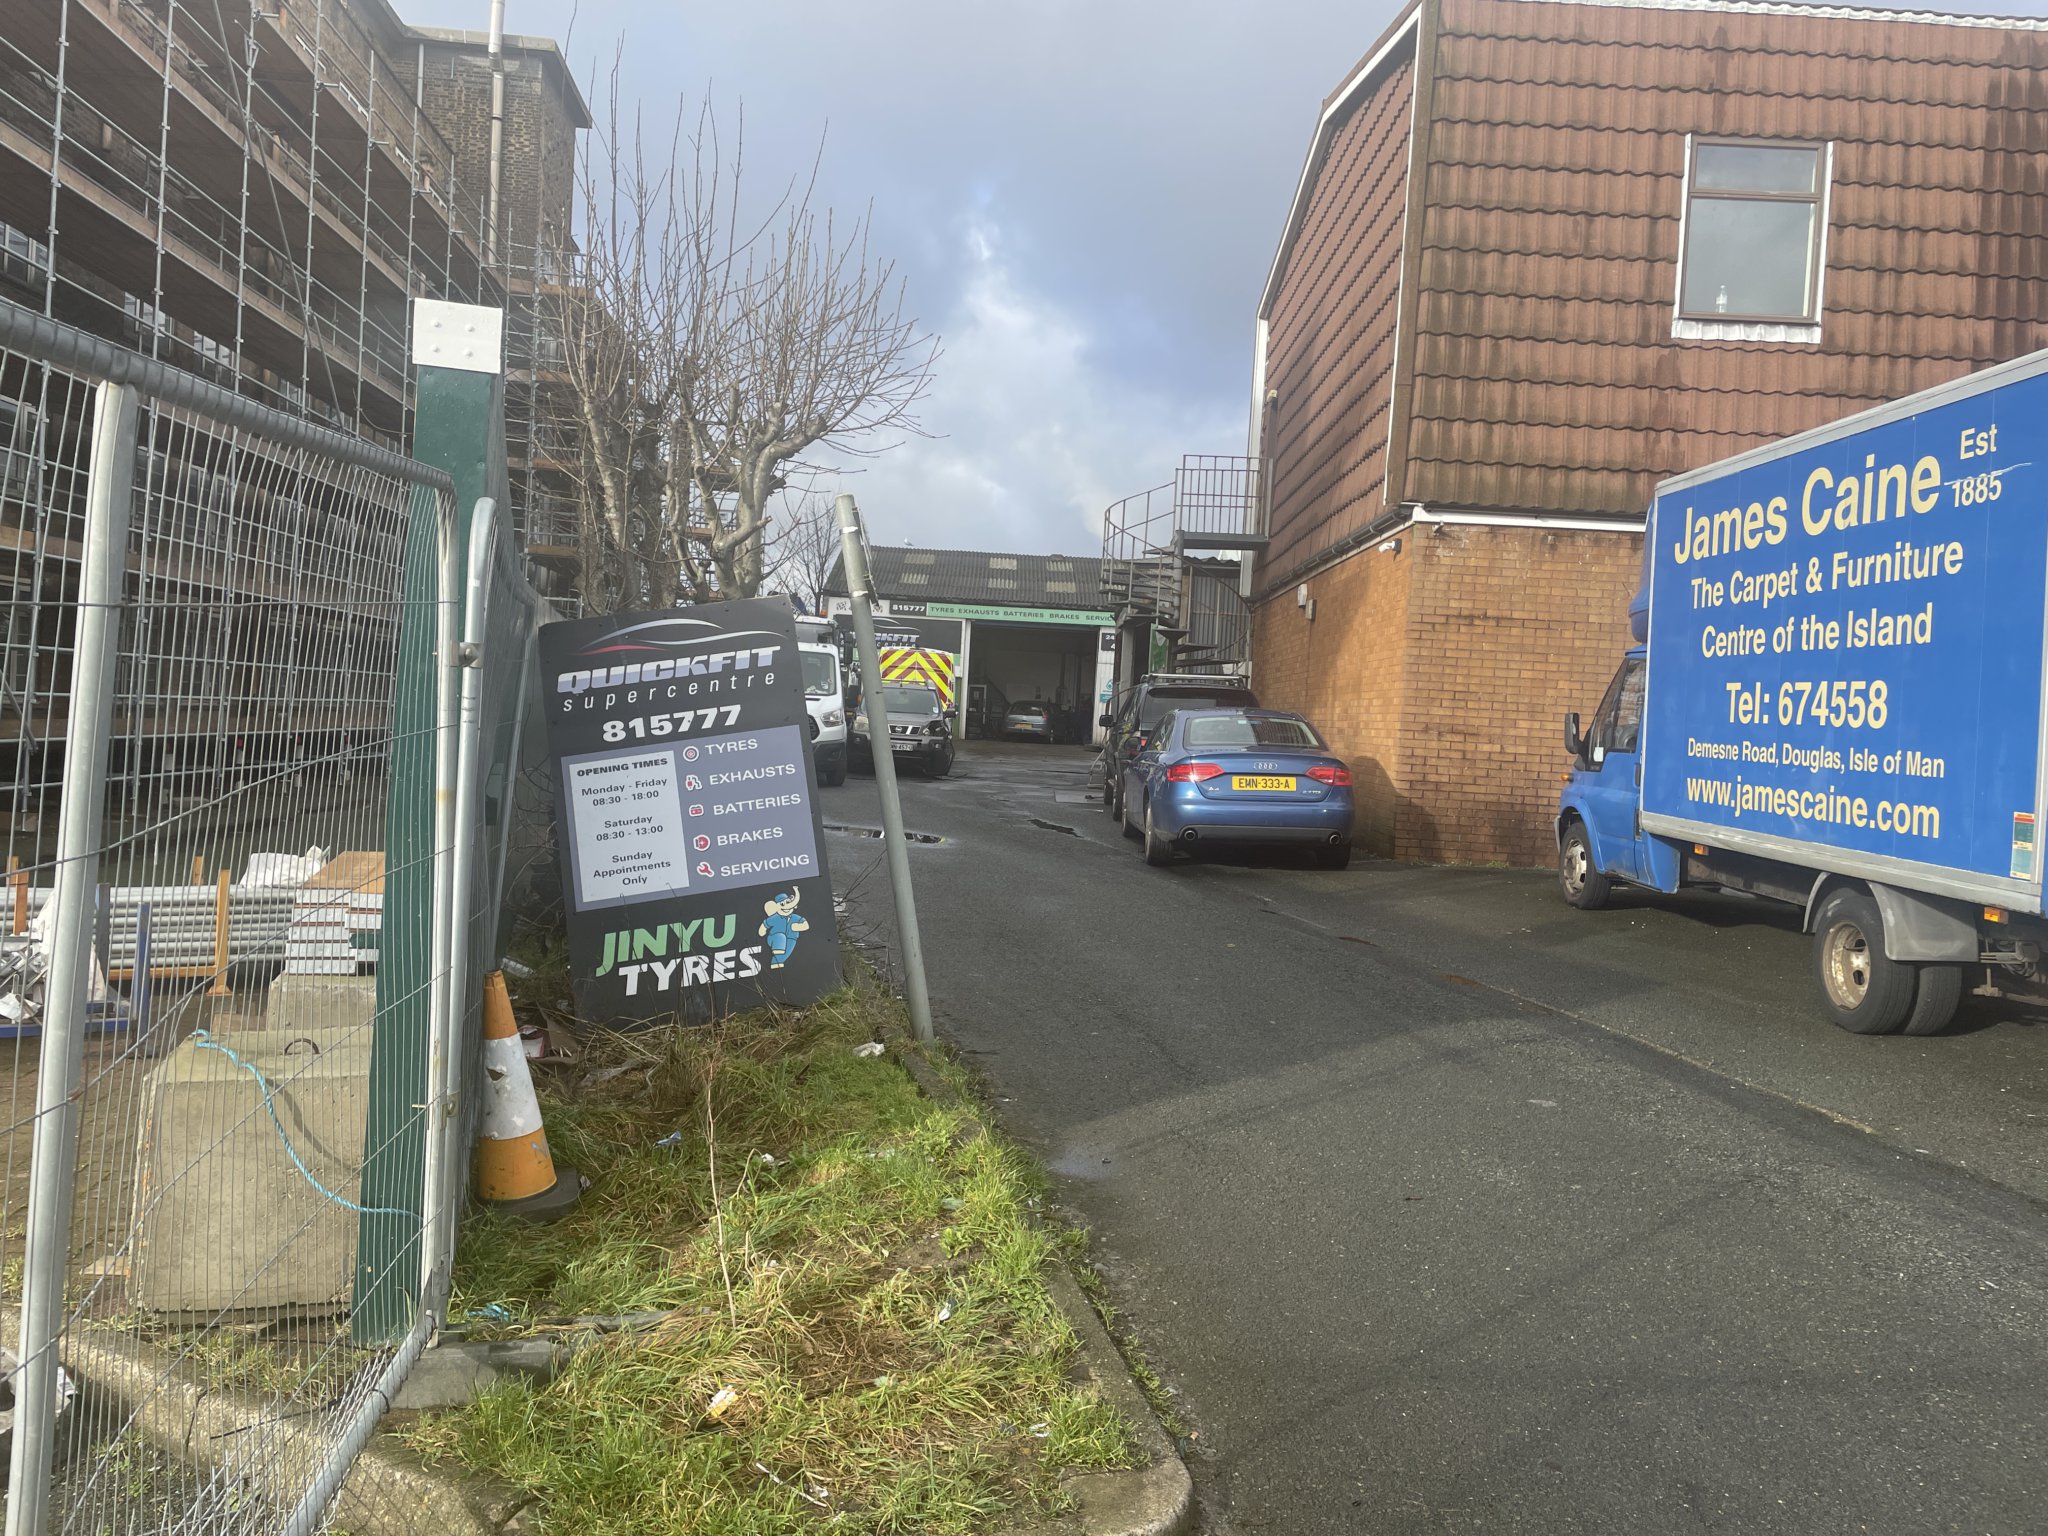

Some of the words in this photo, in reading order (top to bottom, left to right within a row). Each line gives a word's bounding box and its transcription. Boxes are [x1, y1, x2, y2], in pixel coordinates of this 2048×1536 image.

[1960, 424, 1997, 460] Est
[1951, 471, 2002, 508] 1885
[1674, 496, 1787, 565] James
[1801, 453, 1941, 536] Caine
[1691, 577, 1724, 609] The
[1730, 562, 1798, 609] Carpet
[1805, 557, 1823, 593] &
[1831, 540, 1964, 590] Furniture
[892, 604, 925, 612] 815777
[958, 608, 999, 616] EXHAUSTS
[1003, 610, 1044, 618] BATTERIES
[1702, 624, 1766, 658] Centre
[1772, 616, 1795, 653] of
[1801, 614, 1840, 651] the
[1847, 602, 1933, 648] Island
[557, 646, 780, 694] QUICKFIT
[563, 672, 775, 711] supercentre
[1726, 682, 1770, 724] Tel:
[1778, 680, 1888, 729] 674558
[602, 704, 741, 742] 815777
[705, 738, 758, 755] TYRES
[577, 763, 629, 776] OPENING
[632, 758, 668, 769] TIMES
[1688, 738, 1739, 761] Demesne
[1742, 740, 1779, 768] Road,
[1782, 743, 1845, 774] Douglas,
[1849, 748, 1878, 773] Isle
[1883, 750, 1902, 774] of
[1906, 751, 1945, 778] Man
[709, 764, 796, 785] EXHAUSTS
[1238, 778, 1290, 789] EMN-333-A
[581, 784, 625, 796] Monday
[635, 778, 668, 789] Friday
[592, 795, 621, 806] 08:30
[631, 790, 659, 801] 18:00
[713, 793, 801, 815] BATTERIES
[1687, 775, 1940, 839] www.jamescaine.com
[604, 816, 653, 828] Saturday
[596, 830, 625, 842] 08:30
[635, 825, 664, 836] 13:00
[717, 827, 783, 846] BRAKES
[612, 851, 653, 863] Sunday
[720, 854, 810, 877] SERVICING
[593, 861, 671, 878] Appointments
[622, 875, 648, 886] Only
[595, 913, 737, 977] JINYU
[618, 945, 762, 997] TYRES
